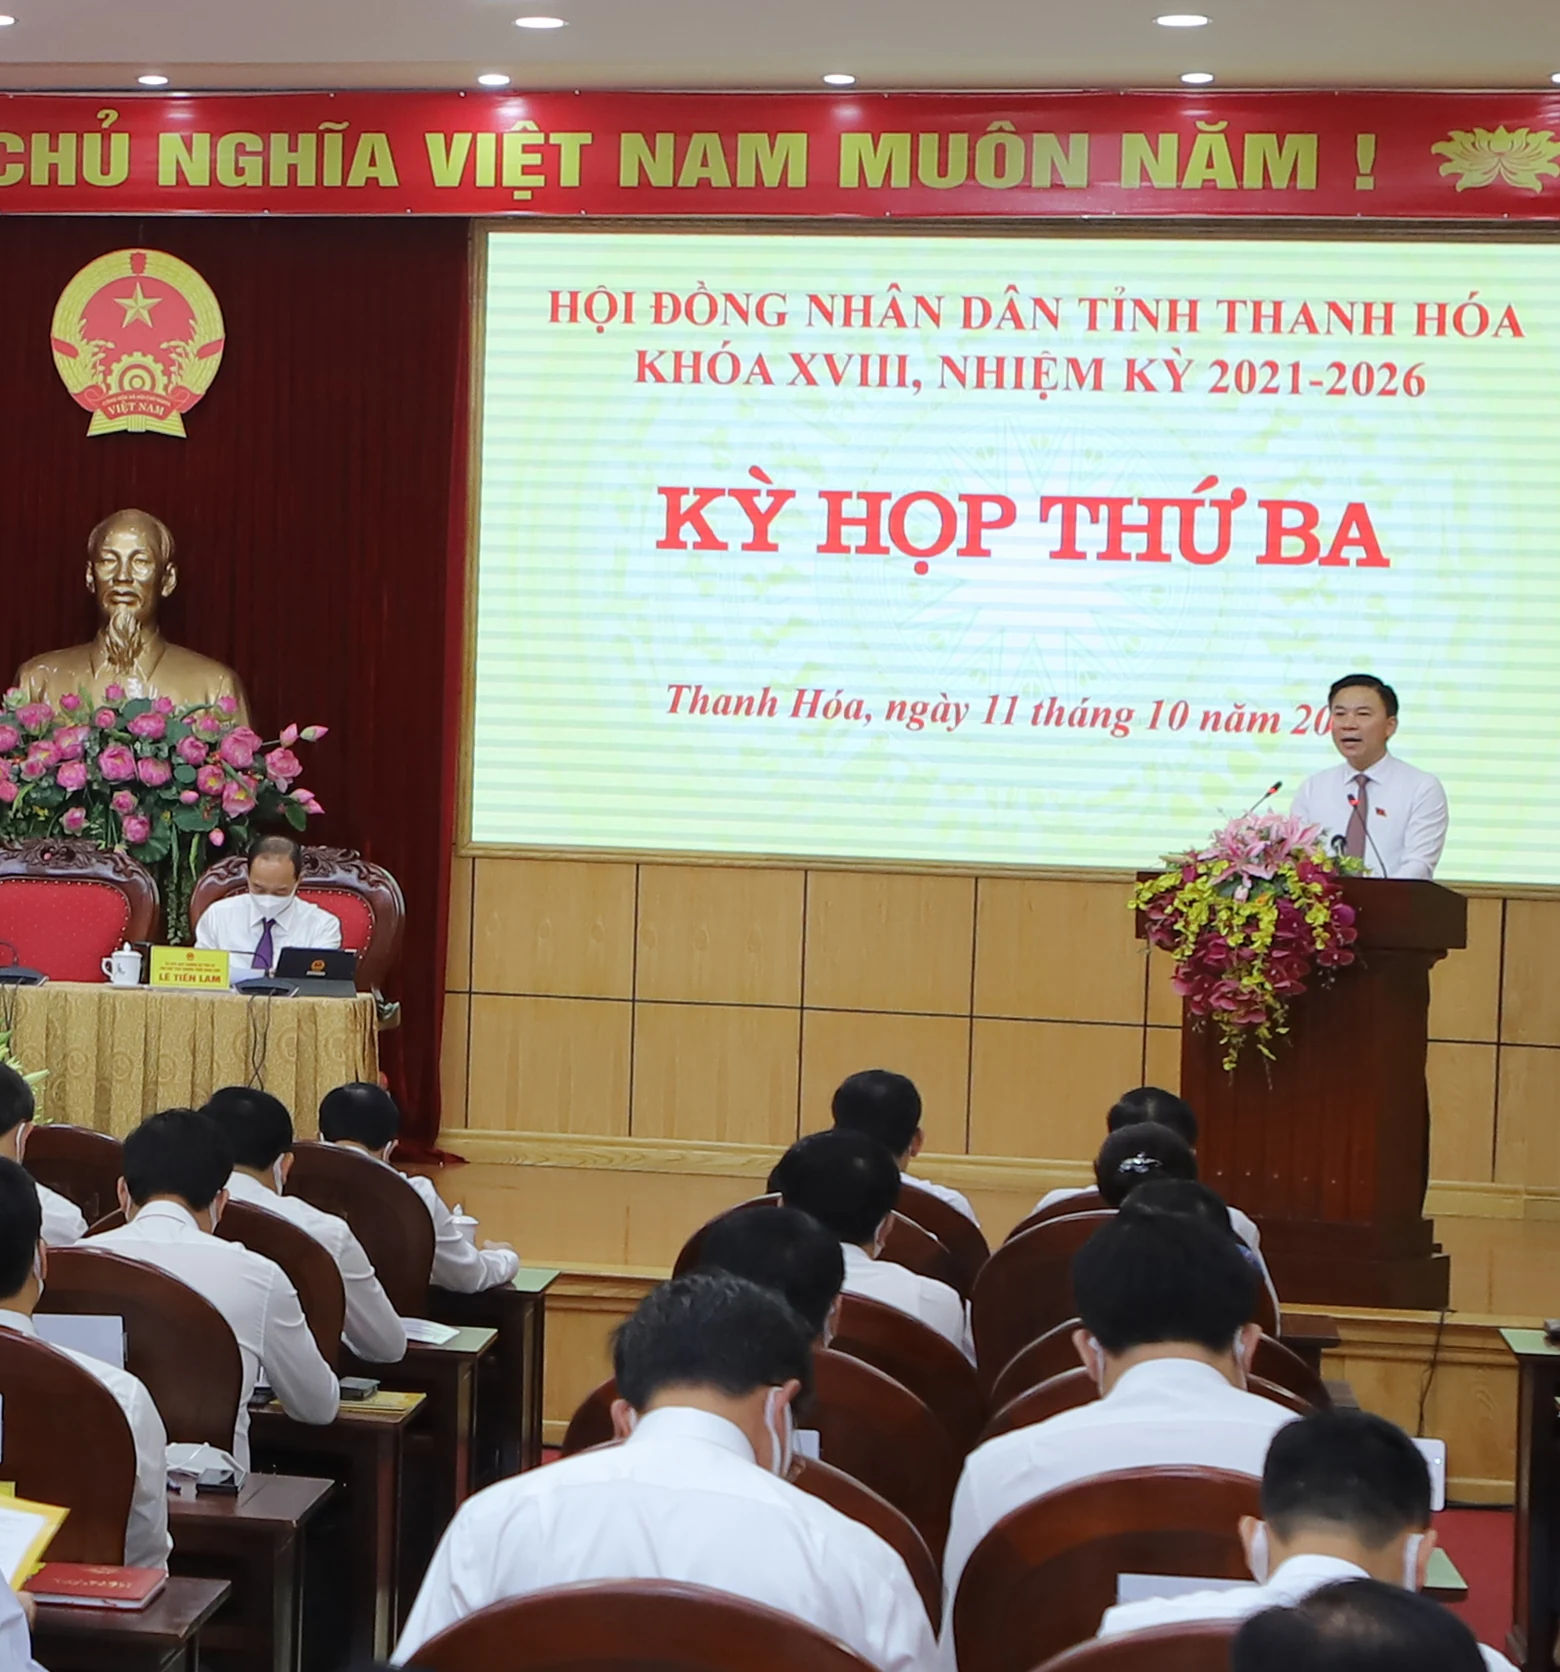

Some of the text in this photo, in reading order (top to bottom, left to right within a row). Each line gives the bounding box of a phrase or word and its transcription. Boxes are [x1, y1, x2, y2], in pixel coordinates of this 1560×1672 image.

[157, 122, 399, 188] NGHĨA
[424, 120, 593, 200] VIỆT
[619, 131, 808, 188] NAM
[840, 120, 1090, 190] MUÔN
[1121, 120, 1318, 190] NĂM
[1355, 133, 1375, 191] !
[548, 281, 1525, 338] HỘI ĐỒNG NHÂN DÂN TỈNH THANH HÓA
[635, 340, 1427, 401] KHÓA XVIII, NHIỆM KỲ 2021-2026
[655, 465, 1392, 576] KỲ HỌP THỨ BA
[668, 683, 779, 719] Thanh
[790, 687, 873, 727] Hóa,
[884, 692, 967, 732] ngày
[985, 696, 1019, 726] 11
[1031, 696, 1135, 738] tháng
[1148, 699, 1190, 731] 10
[1199, 703, 1281, 735] năm
